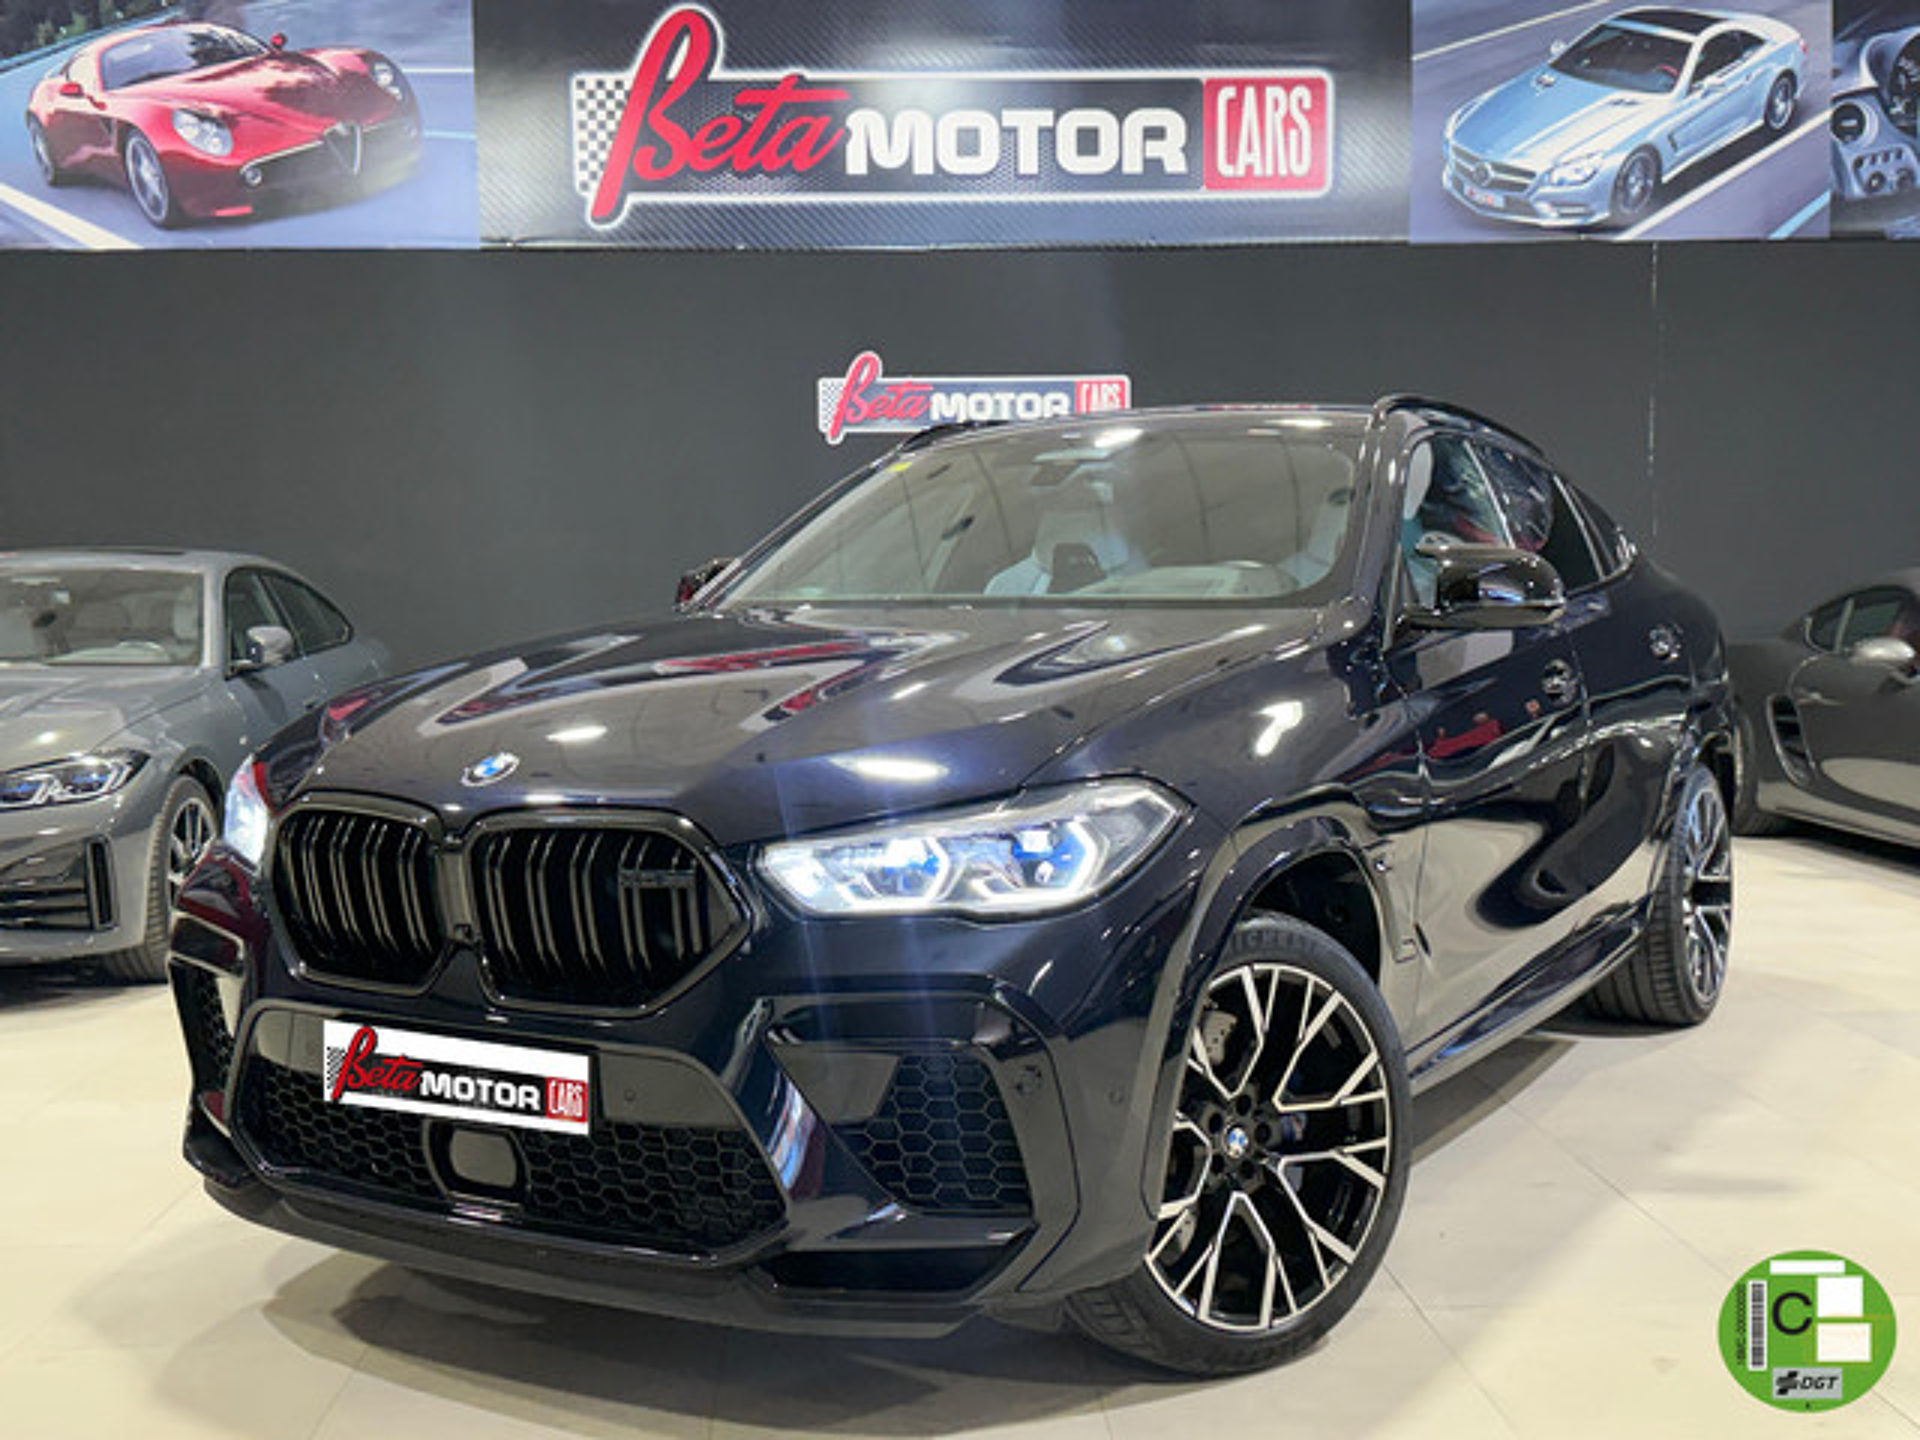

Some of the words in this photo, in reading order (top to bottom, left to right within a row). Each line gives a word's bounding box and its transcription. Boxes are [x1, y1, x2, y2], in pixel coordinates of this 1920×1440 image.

[845, 108, 1188, 176] MOTOR
[1216, 85, 1312, 179] CARS
[930, 391, 1071, 422] MOTOR
[1078, 382, 1122, 413] CARS
[419, 1070, 541, 1110] MOTOR
[549, 1079, 584, 1118] CARS
